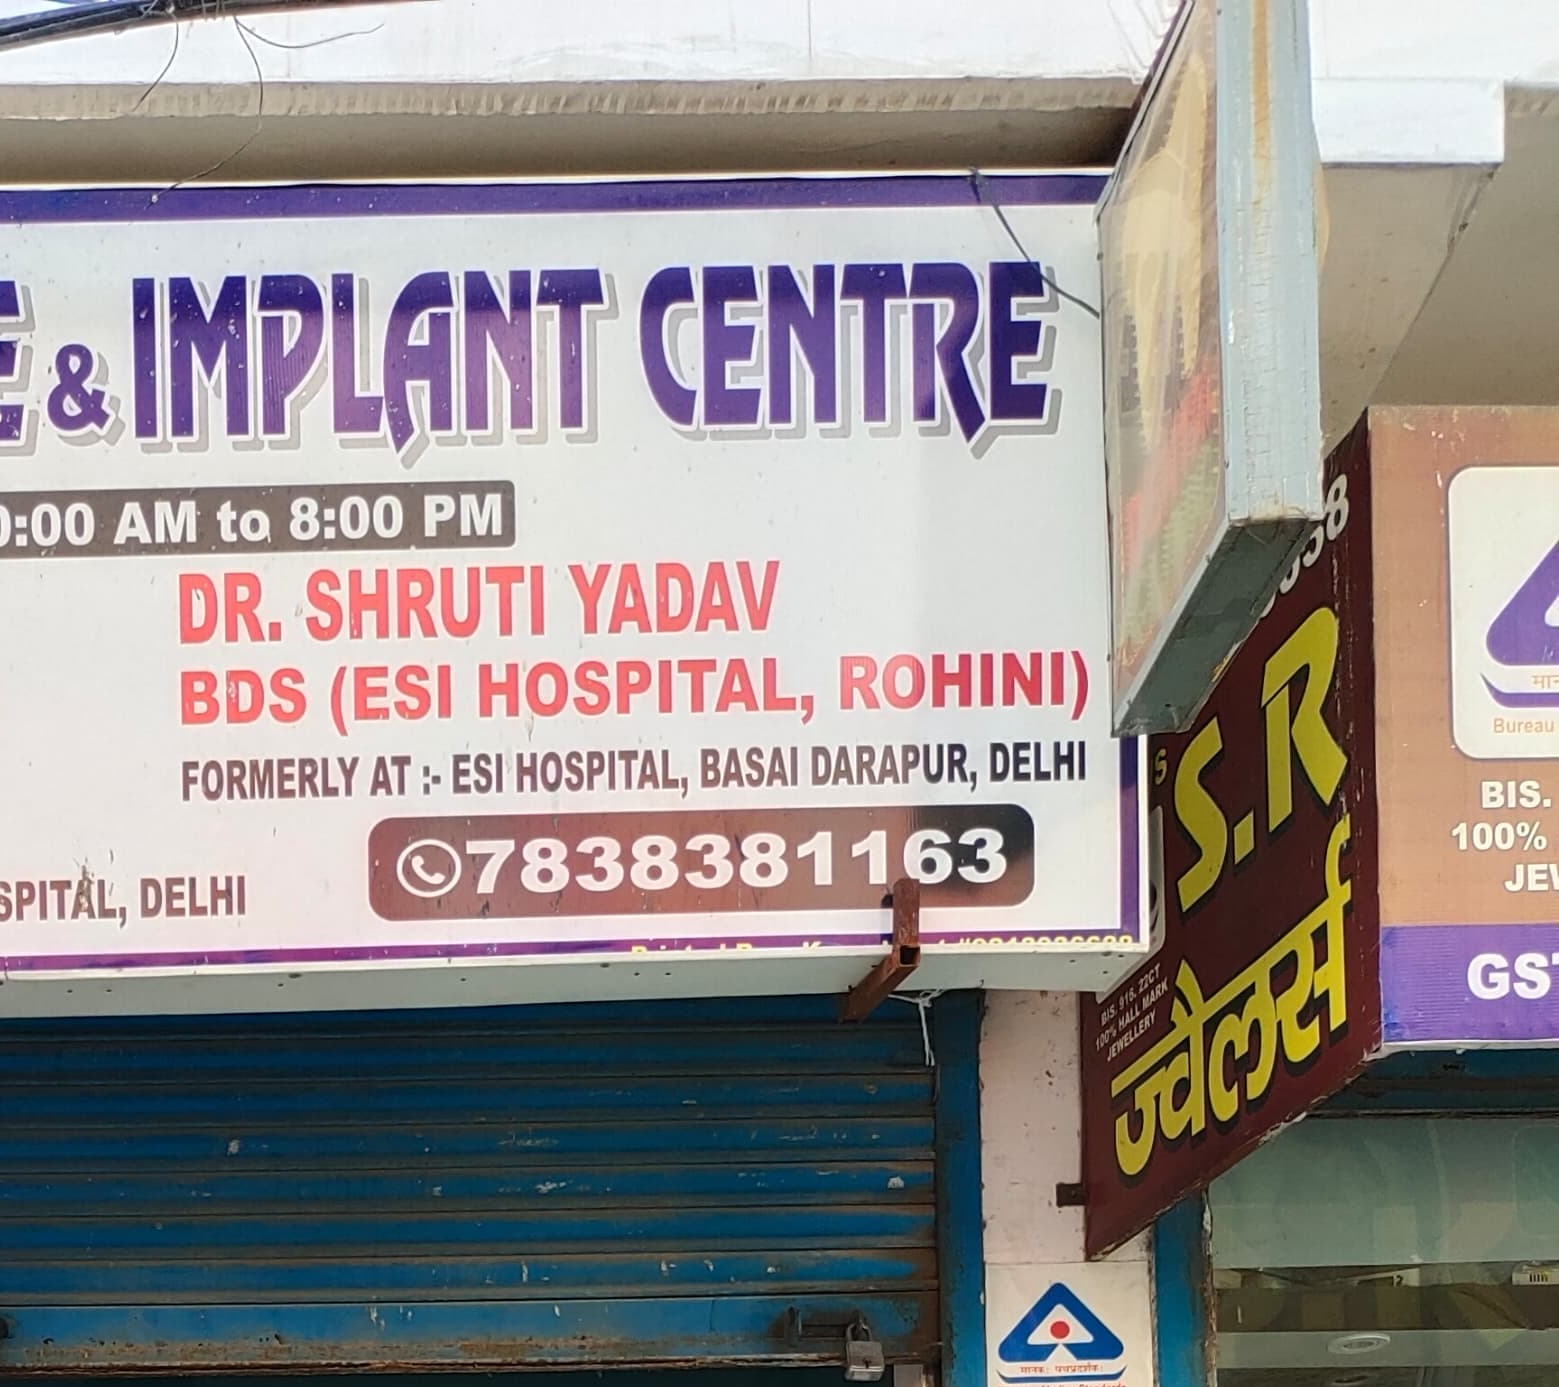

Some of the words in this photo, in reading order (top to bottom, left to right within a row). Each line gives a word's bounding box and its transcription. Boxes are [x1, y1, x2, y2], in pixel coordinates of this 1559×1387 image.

[46, 343, 118, 433] &
[132, 268, 610, 455] IMPLANT
[638, 261, 1048, 446] CENTRE
[114, 500, 199, 545] AM
[217, 504, 271, 543] to
[289, 493, 404, 542] 8:00
[424, 491, 503, 538] PM
[178, 570, 283, 644] DR.
[305, 563, 546, 642] SHRUTI
[567, 559, 780, 635] YADAV
[179, 666, 308, 726] BDS
[329, 662, 452, 737] (ESI
[478, 656, 815, 726] HOSPITAL,
[840, 649, 1092, 722] ROHINI)
[1493, 717, 1555, 734] Bureau
[181, 755, 359, 802] FORMERLY
[369, 752, 414, 797] AT
[450, 750, 504, 796] ESI
[514, 746, 691, 800] HOSPITAL,
[700, 745, 800, 790] BASAI
[811, 742, 980, 792] DARAPUR,
[989, 739, 1088, 784] DELHI
[1173, 605, 1350, 914] S.R
[1481, 780, 1552, 809] BIS.
[464, 828, 1008, 896] 7838381163
[1451, 821, 1547, 851] 100%
[140, 873, 247, 920] DELHI
[1118, 1003, 1141, 1032] HALL
[1142, 976, 1169, 1011] MARK
[1466, 952, 1559, 1001] GS
[1106, 1007, 1157, 1063] JEWELLERY
